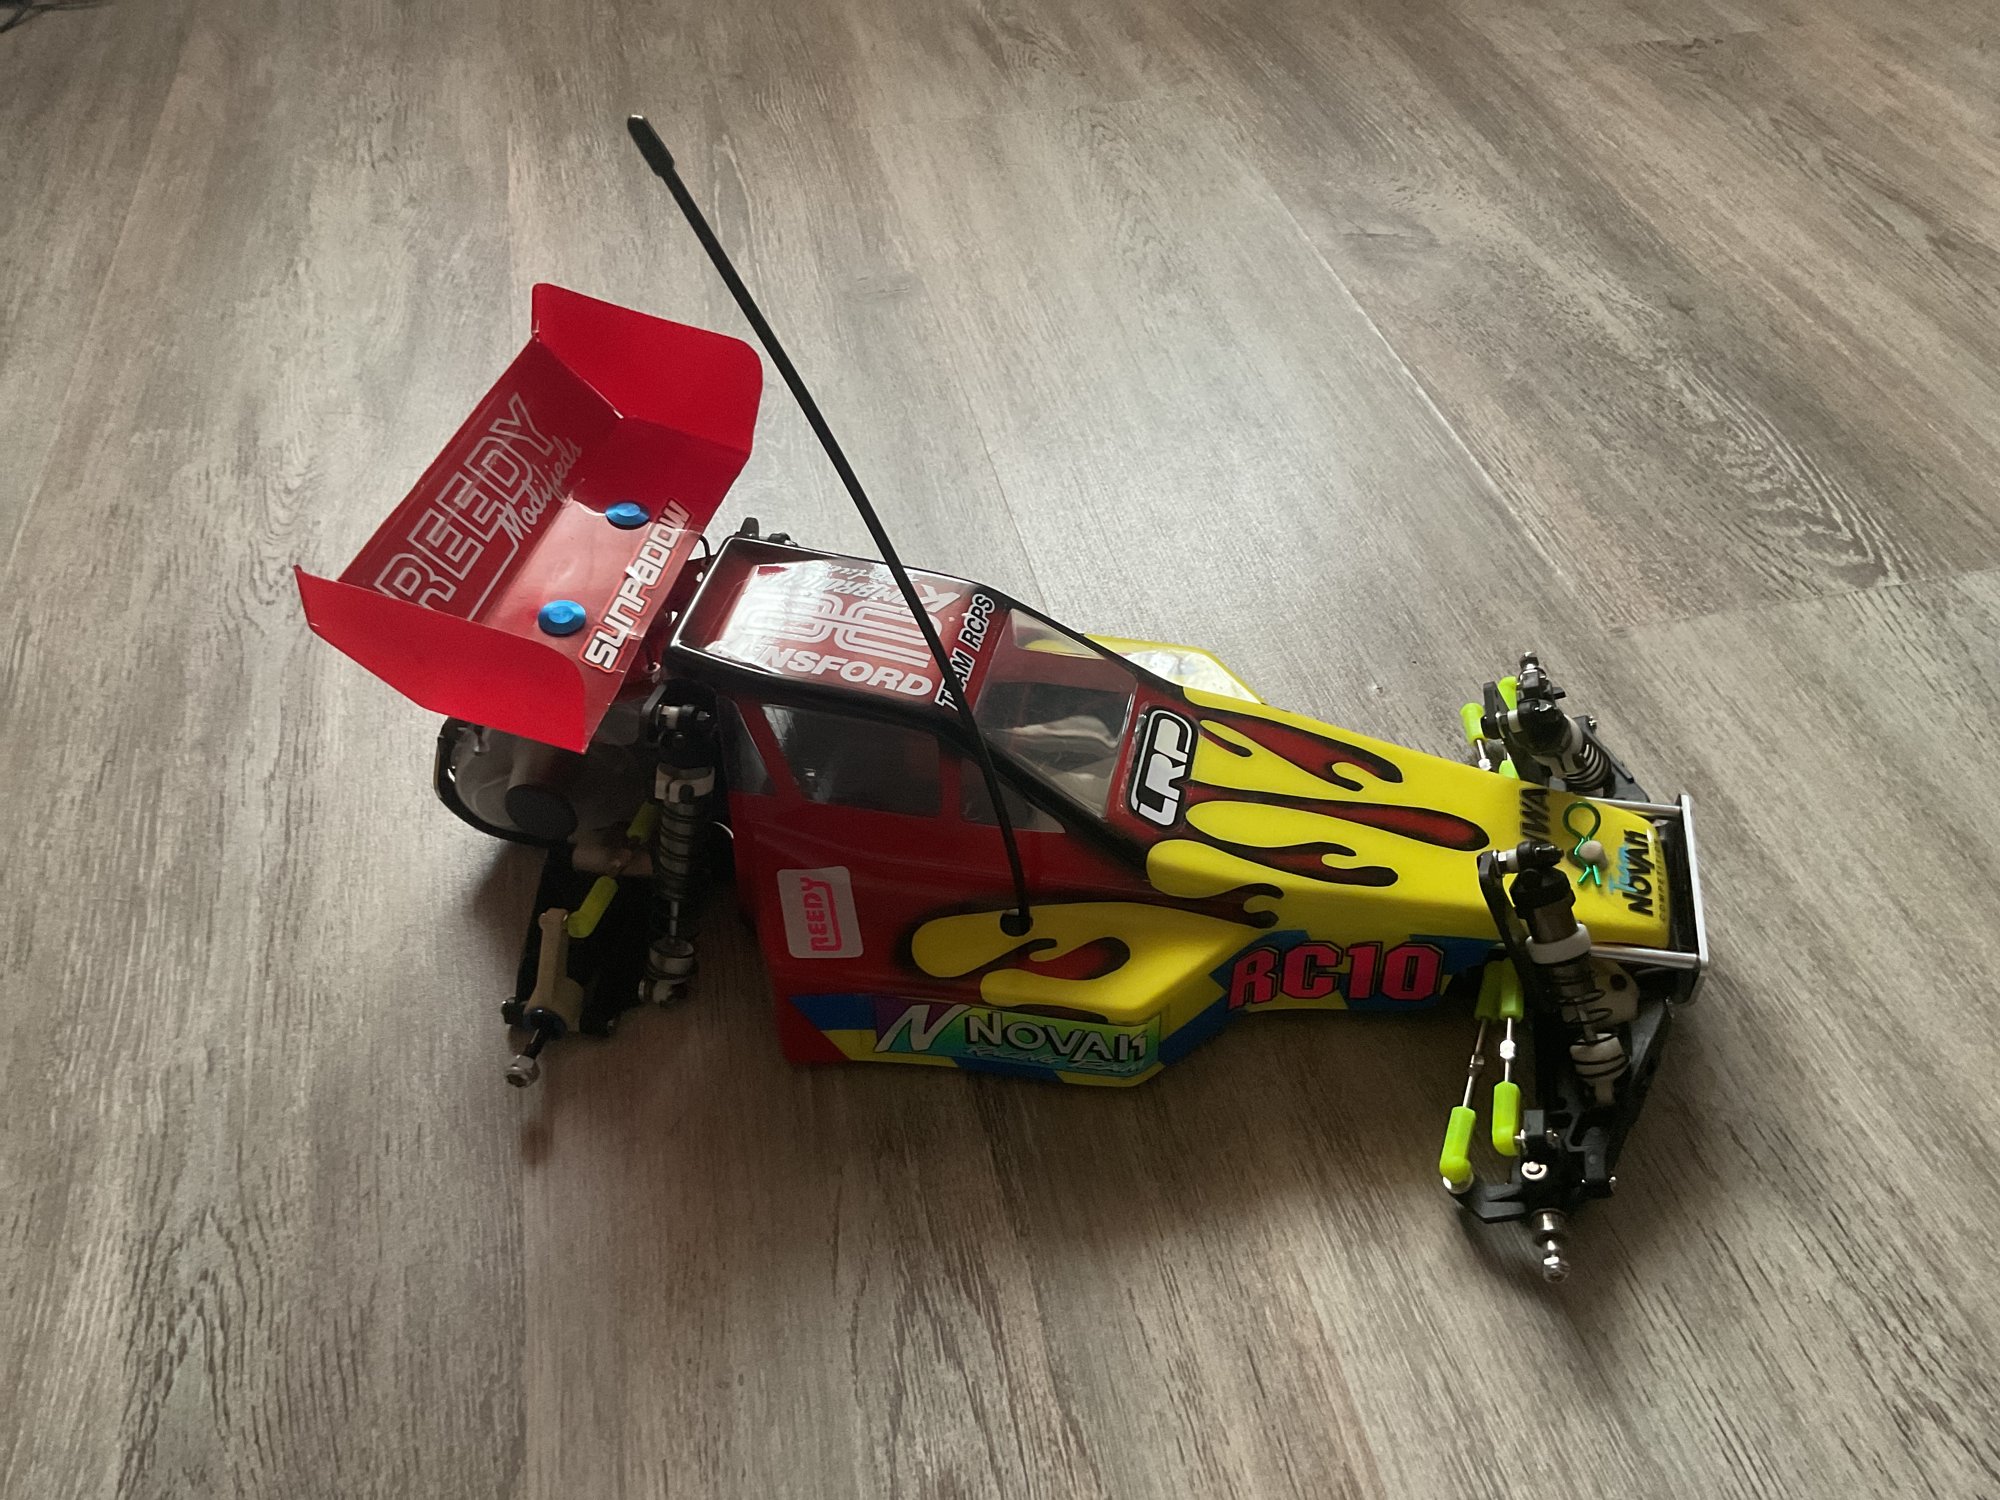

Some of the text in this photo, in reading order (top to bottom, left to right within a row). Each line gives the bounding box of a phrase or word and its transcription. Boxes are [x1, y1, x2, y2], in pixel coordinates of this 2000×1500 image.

[373, 392, 555, 608] REEDY
[936, 593, 996, 711] TAM RCPS
[1131, 709, 1193, 826] LRP
[799, 876, 842, 951] REEDY
[1227, 941, 1444, 1010] RC10
